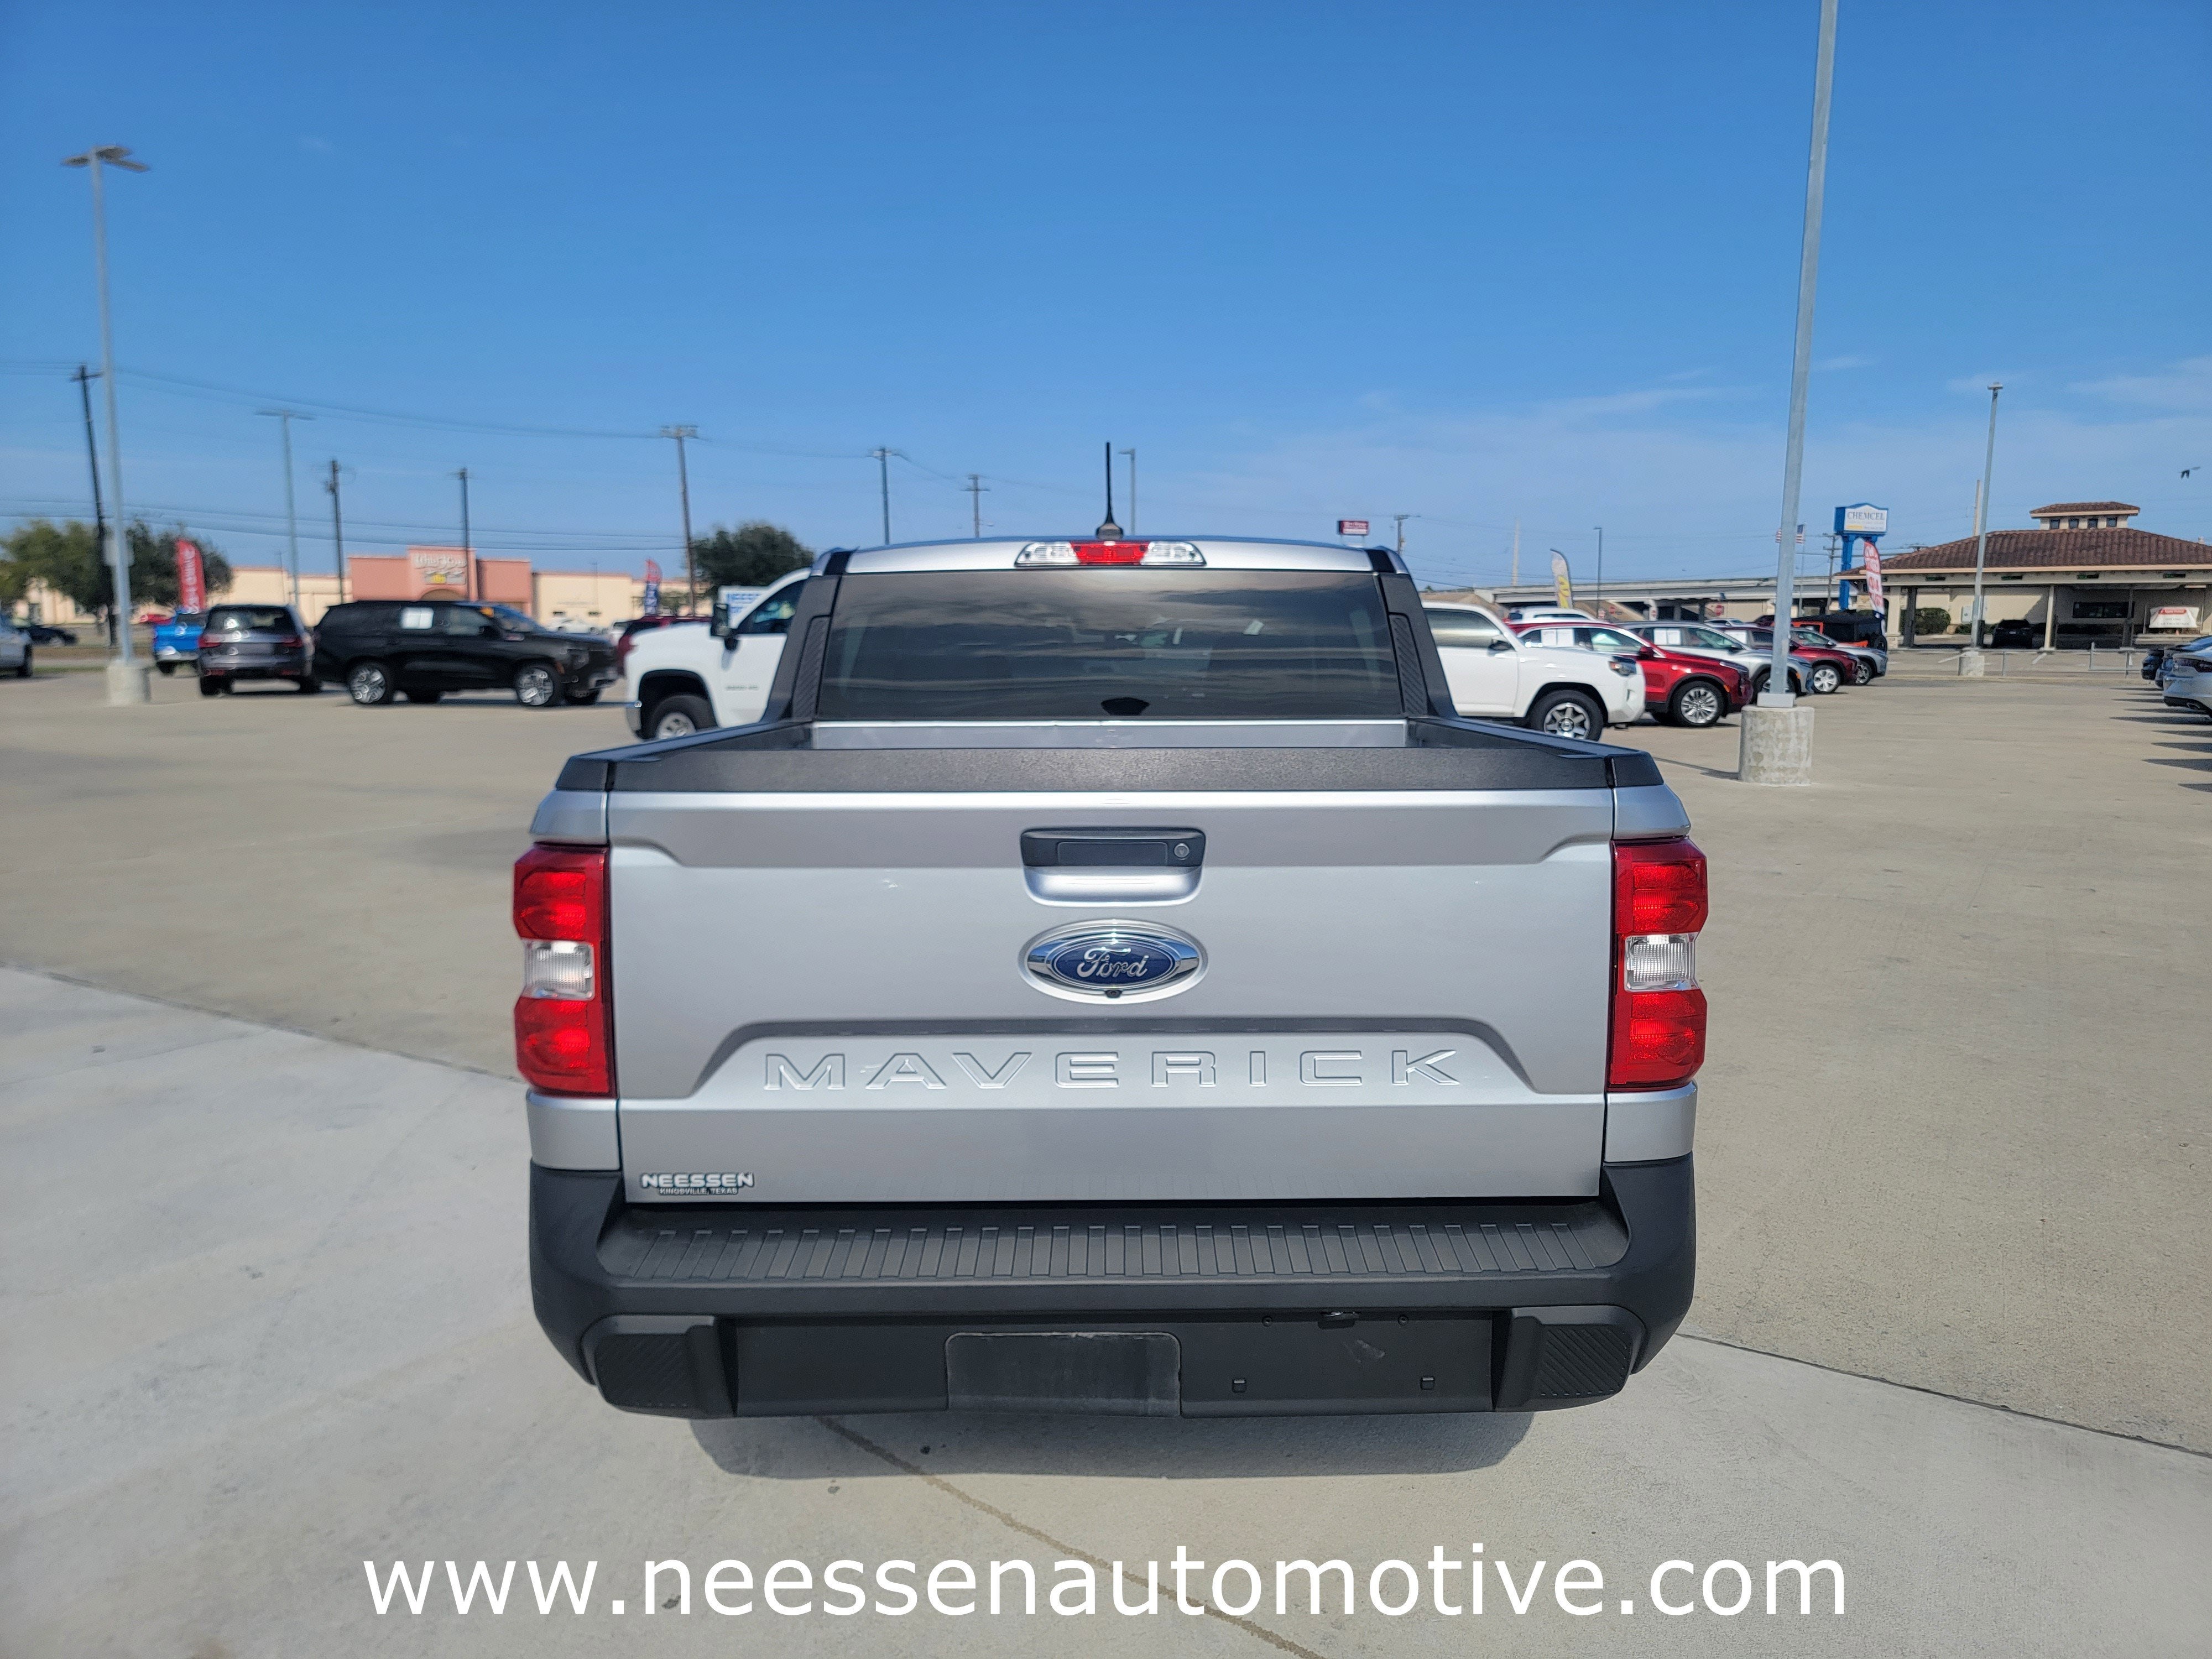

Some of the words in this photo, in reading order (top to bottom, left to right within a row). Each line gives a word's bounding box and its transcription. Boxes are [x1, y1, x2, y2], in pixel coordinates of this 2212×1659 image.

[1847, 512, 1885, 520] CHEMCEL
[1077, 947, 1150, 978] Ford
[764, 1050, 1460, 1089] MAVERICK
[641, 1173, 754, 1188] NEESSEN
